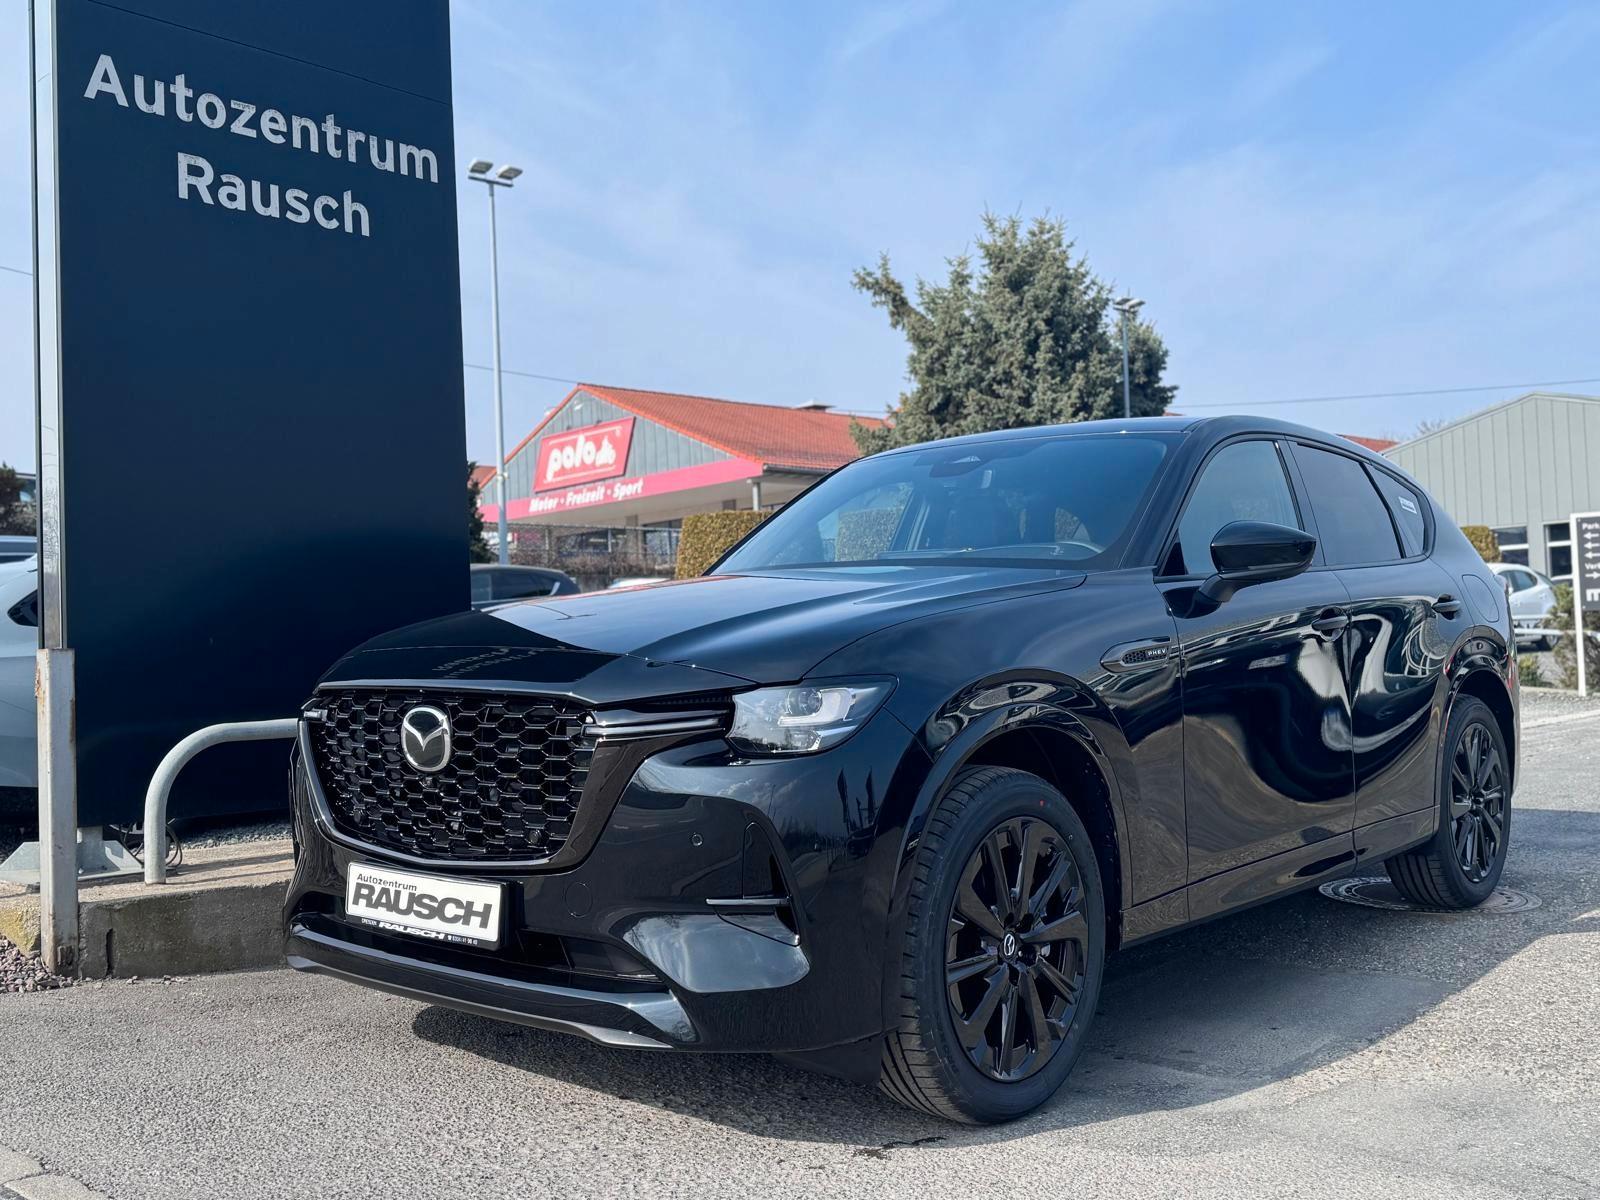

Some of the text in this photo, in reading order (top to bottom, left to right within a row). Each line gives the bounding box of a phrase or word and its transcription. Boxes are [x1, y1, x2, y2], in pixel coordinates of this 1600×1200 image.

[84, 54, 439, 184] Autozentrum
[177, 151, 371, 237] Rausch
[546, 434, 596, 482] polo
[566, 486, 605, 506] Freizeit
[612, 479, 643, 501] Sport
[352, 882, 493, 930] RAUSCH
[356, 873, 418, 892] Autozentrum
[378, 921, 446, 940] RAUSCH
